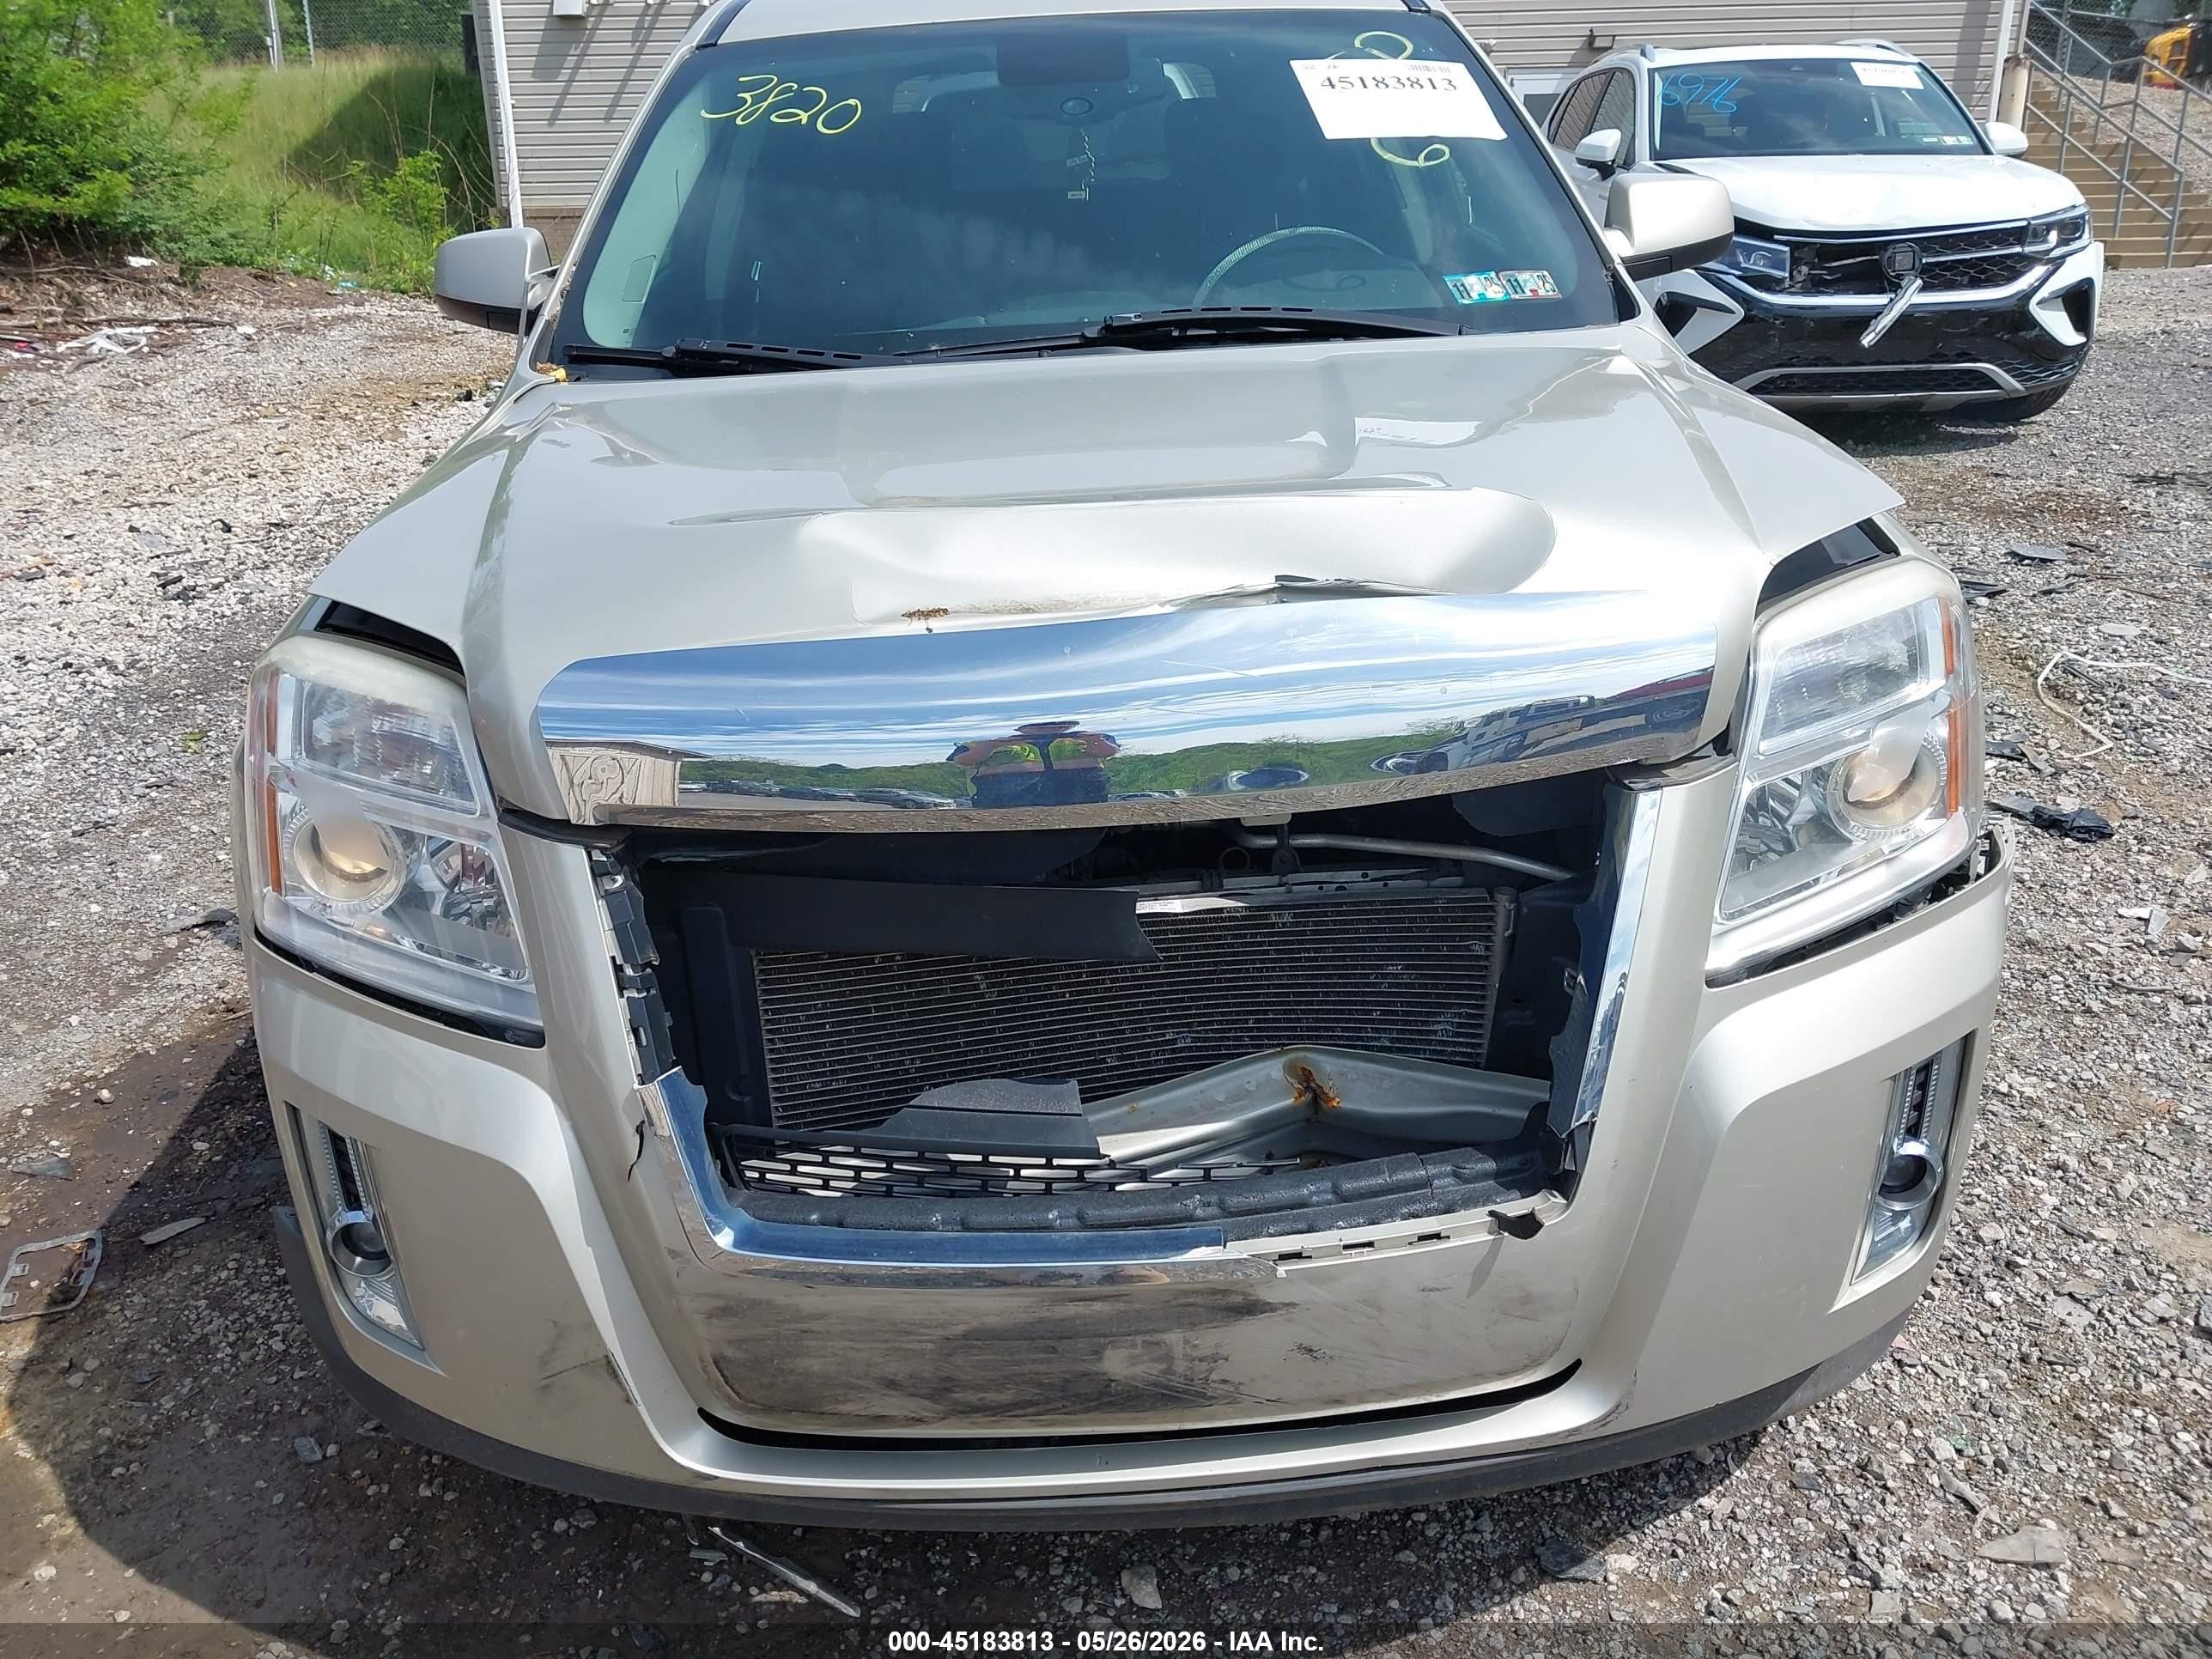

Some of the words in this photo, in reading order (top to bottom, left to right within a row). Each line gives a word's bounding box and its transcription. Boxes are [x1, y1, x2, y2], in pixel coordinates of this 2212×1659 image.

[1320, 75, 1457, 92] 45183813
[700, 74, 863, 135] 3820
[1506, 276, 1527, 295] 11
[1536, 274, 1557, 293] 25
